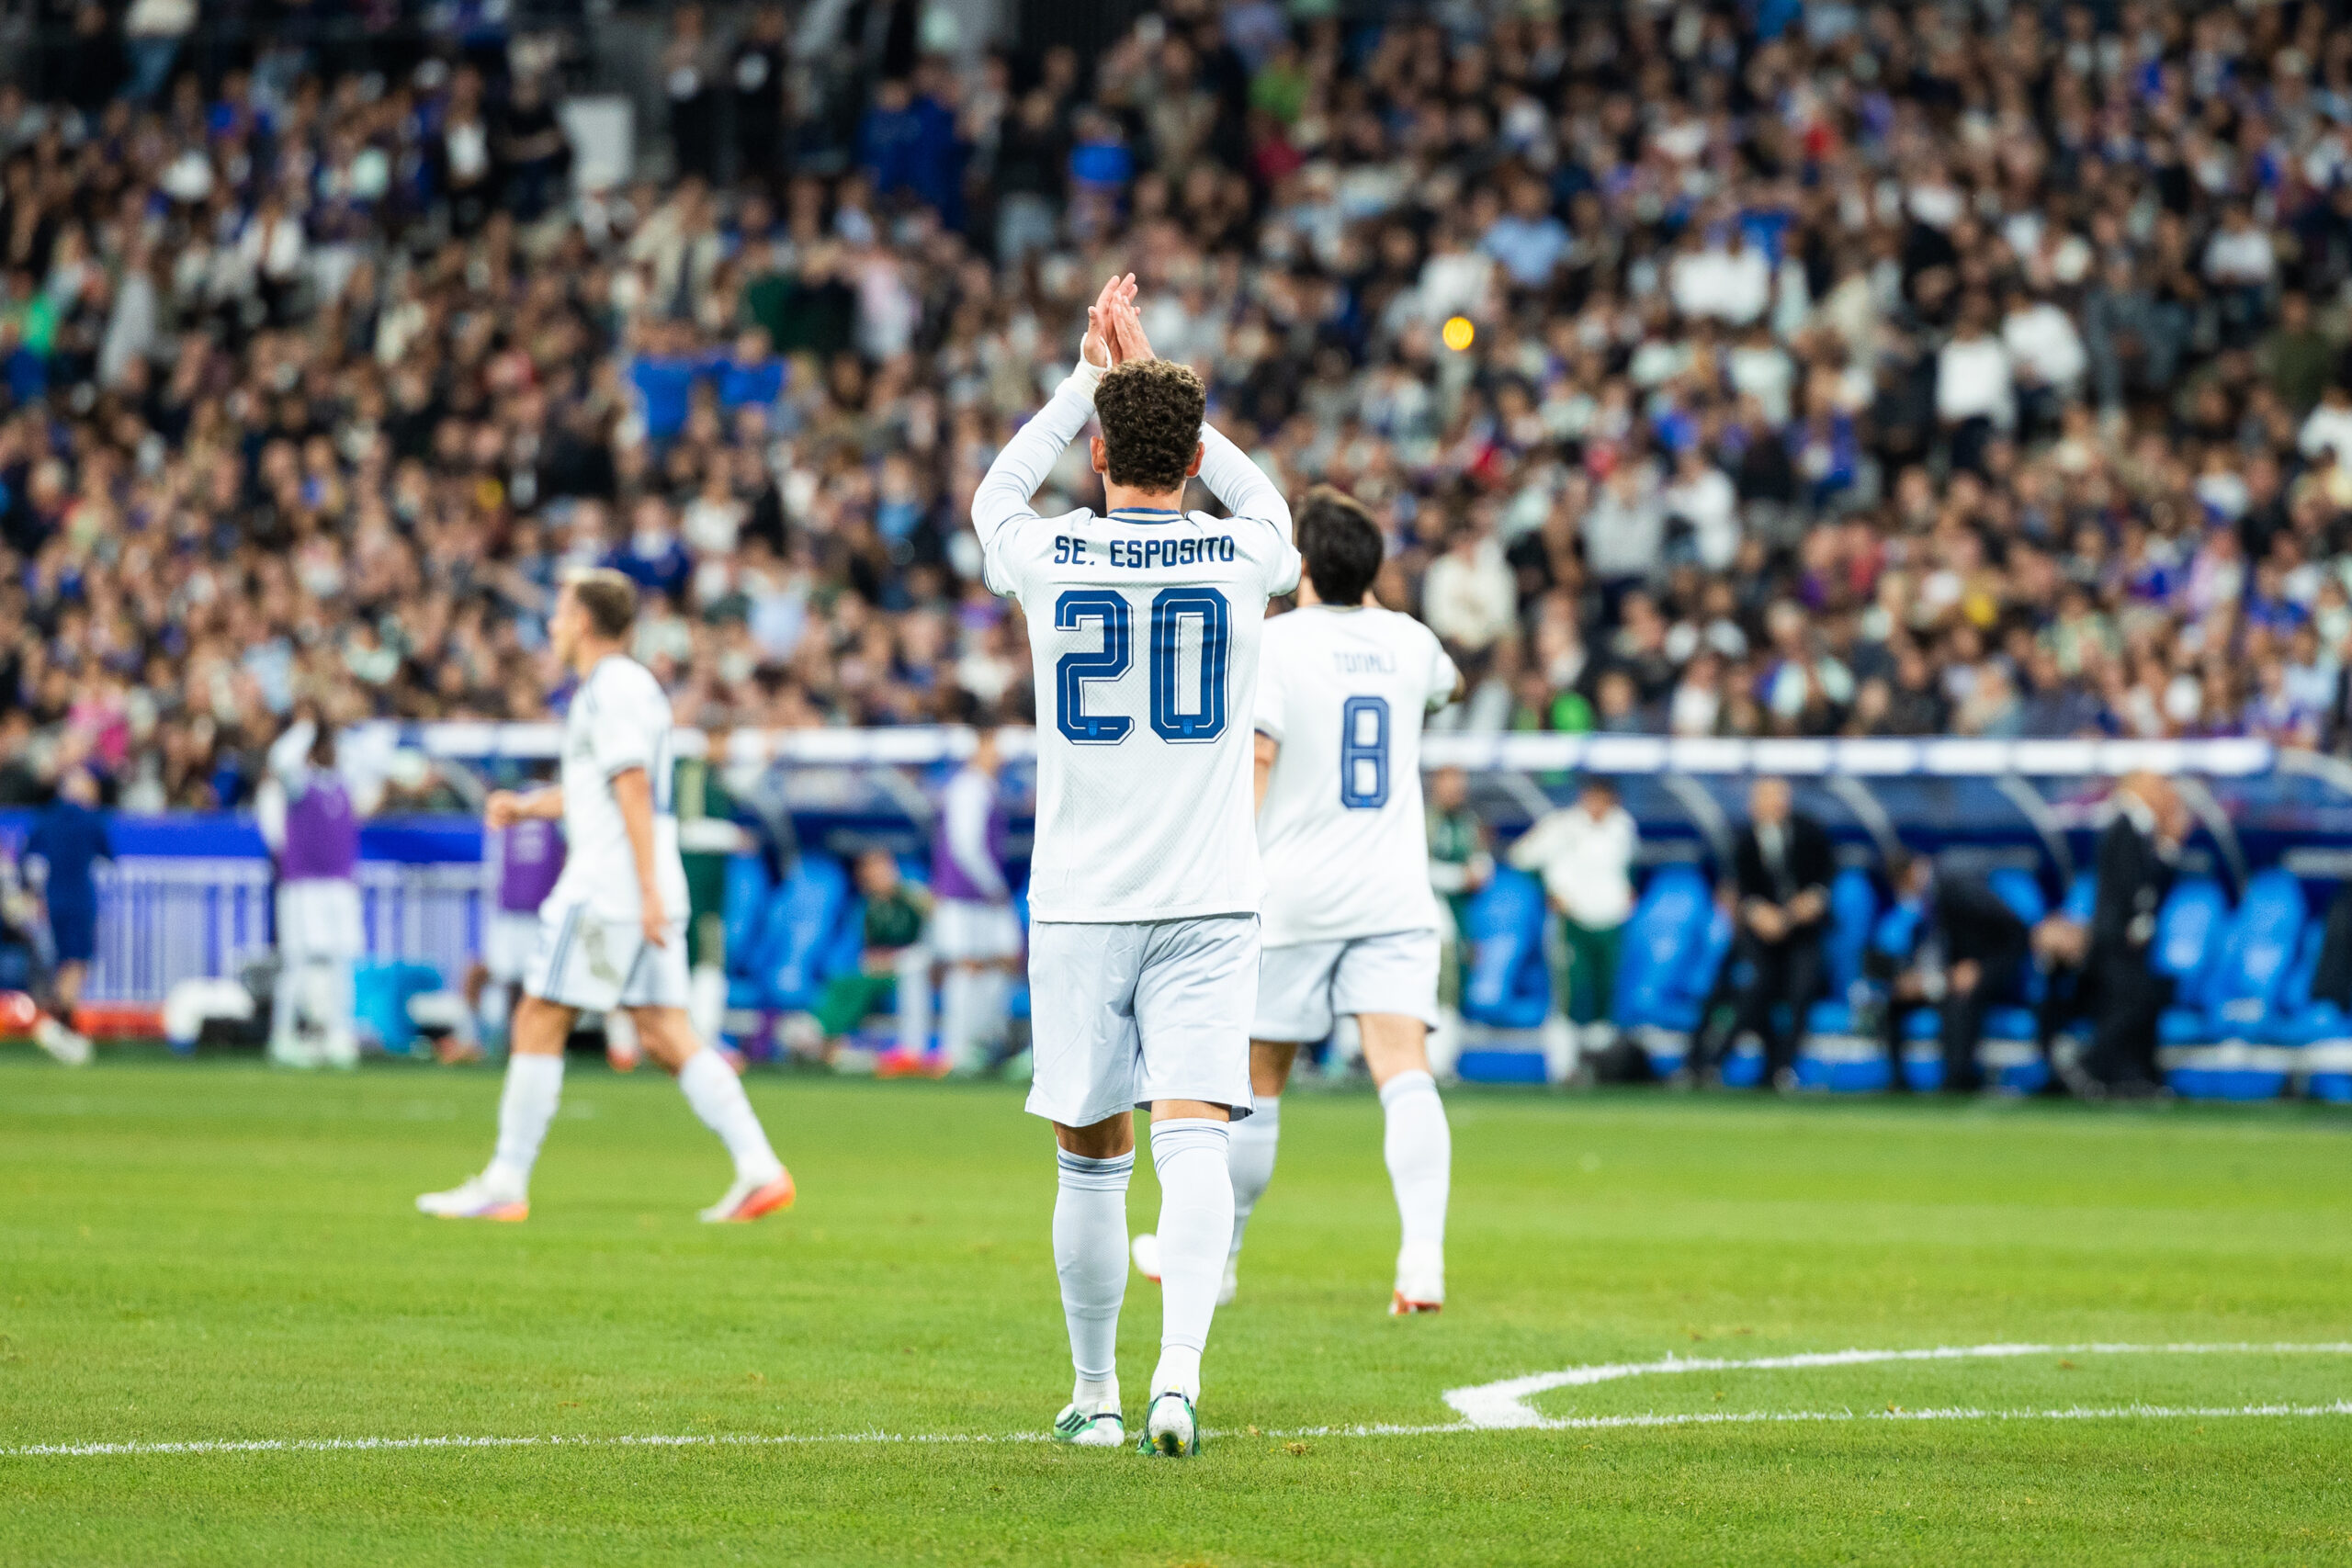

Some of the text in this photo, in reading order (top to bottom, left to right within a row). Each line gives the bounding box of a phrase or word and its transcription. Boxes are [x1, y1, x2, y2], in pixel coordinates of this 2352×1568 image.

[1054, 536, 1235, 569] SE. ESPOSITO
[1055, 588, 1231, 745] 20
[1341, 696, 1390, 808] 8
